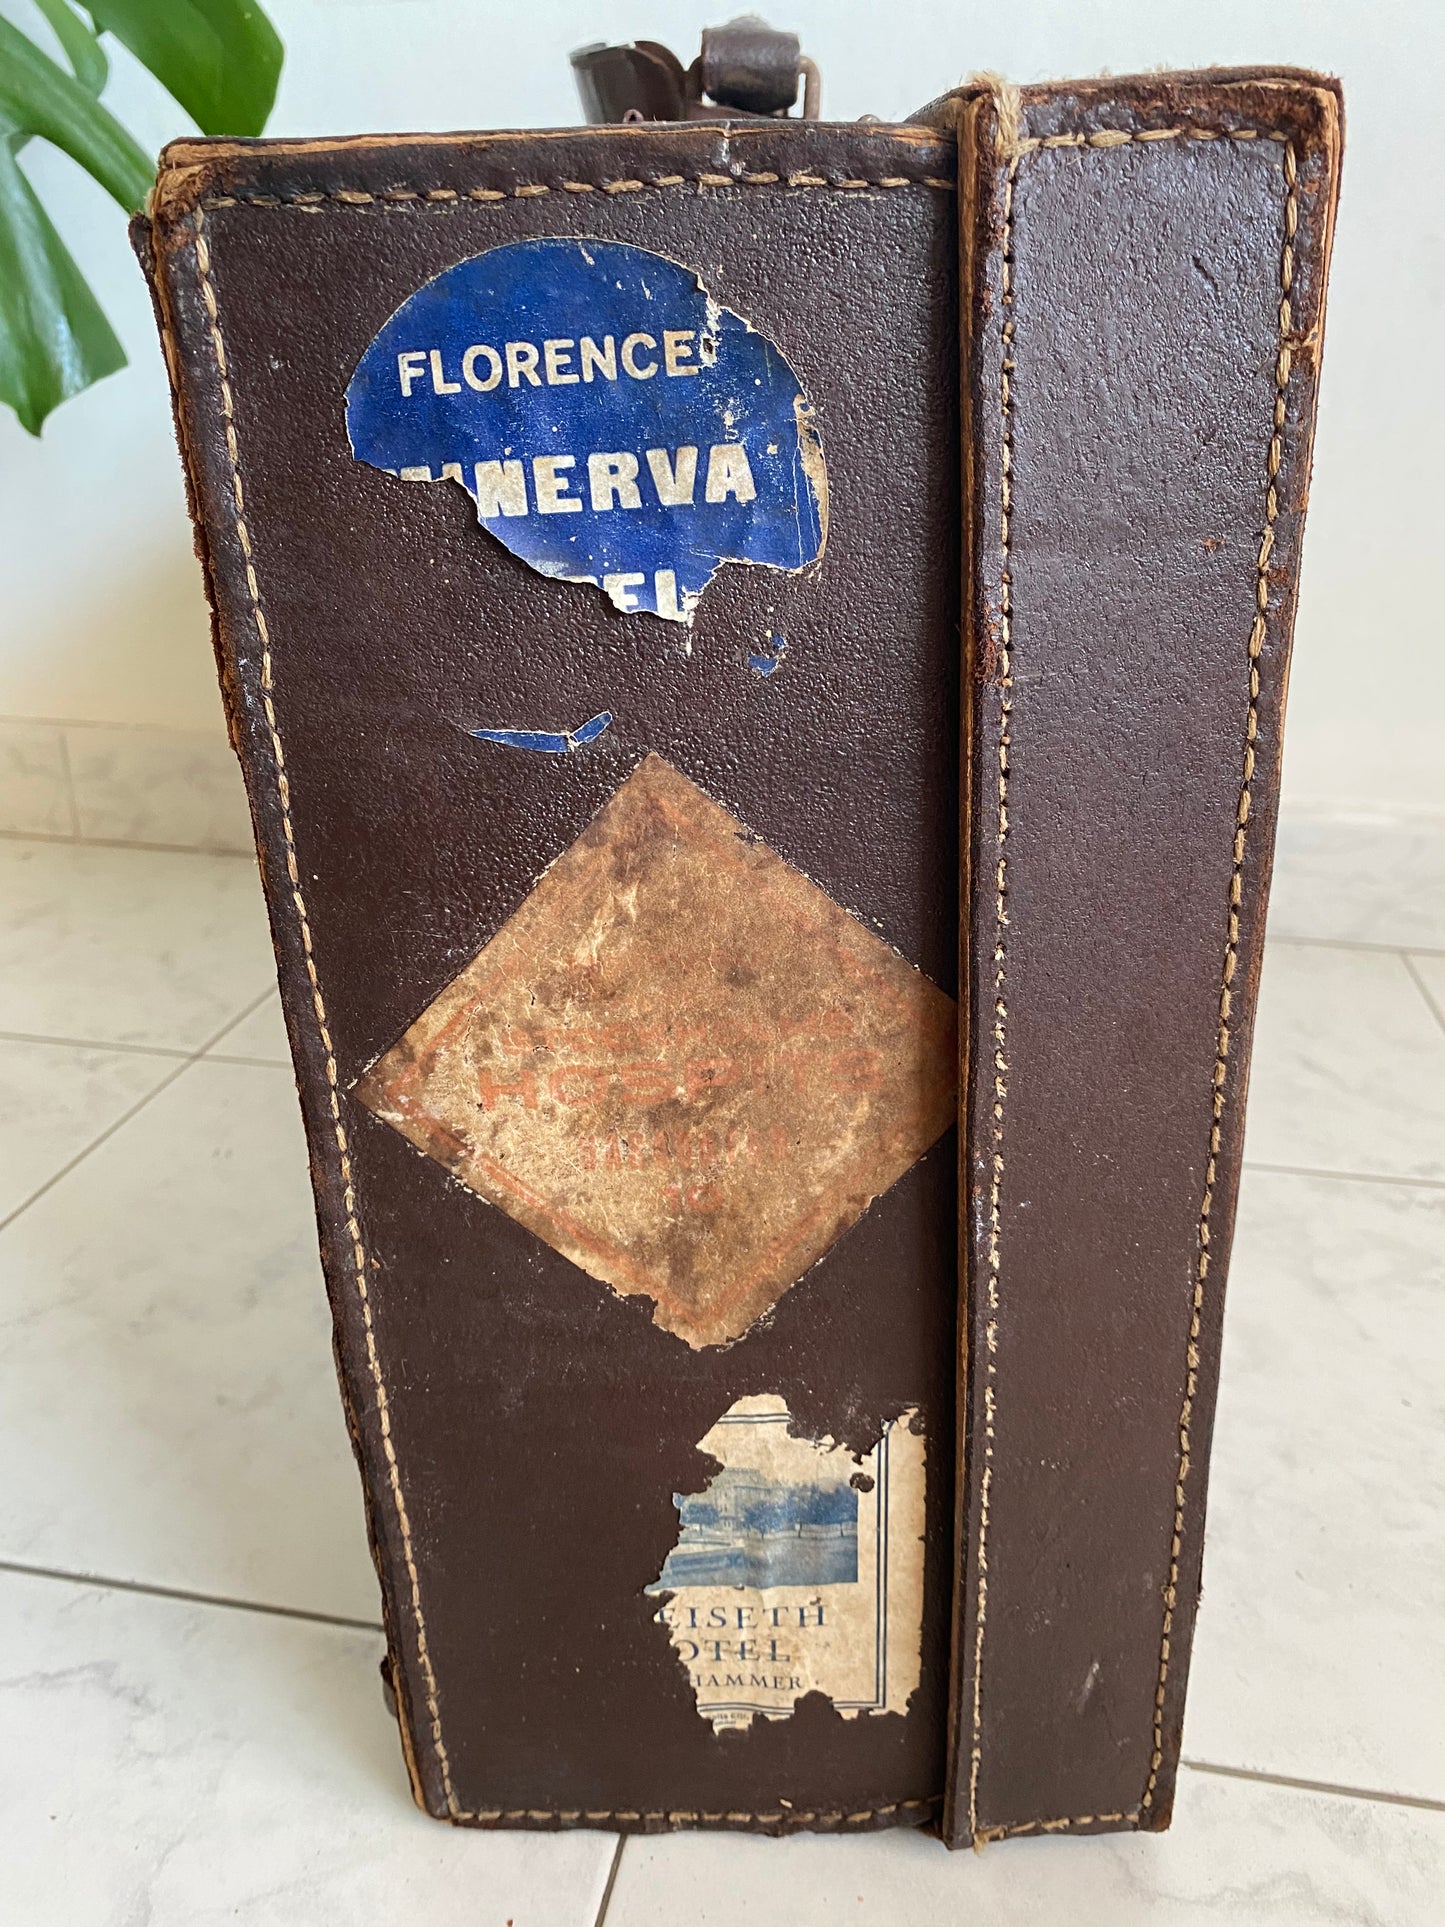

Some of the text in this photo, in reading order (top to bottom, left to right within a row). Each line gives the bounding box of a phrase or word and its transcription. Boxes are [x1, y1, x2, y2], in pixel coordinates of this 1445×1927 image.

[396, 330, 702, 397] FLORENCE
[381, 443, 757, 519] NERVA
[477, 1047, 886, 1111] HOSPITS
